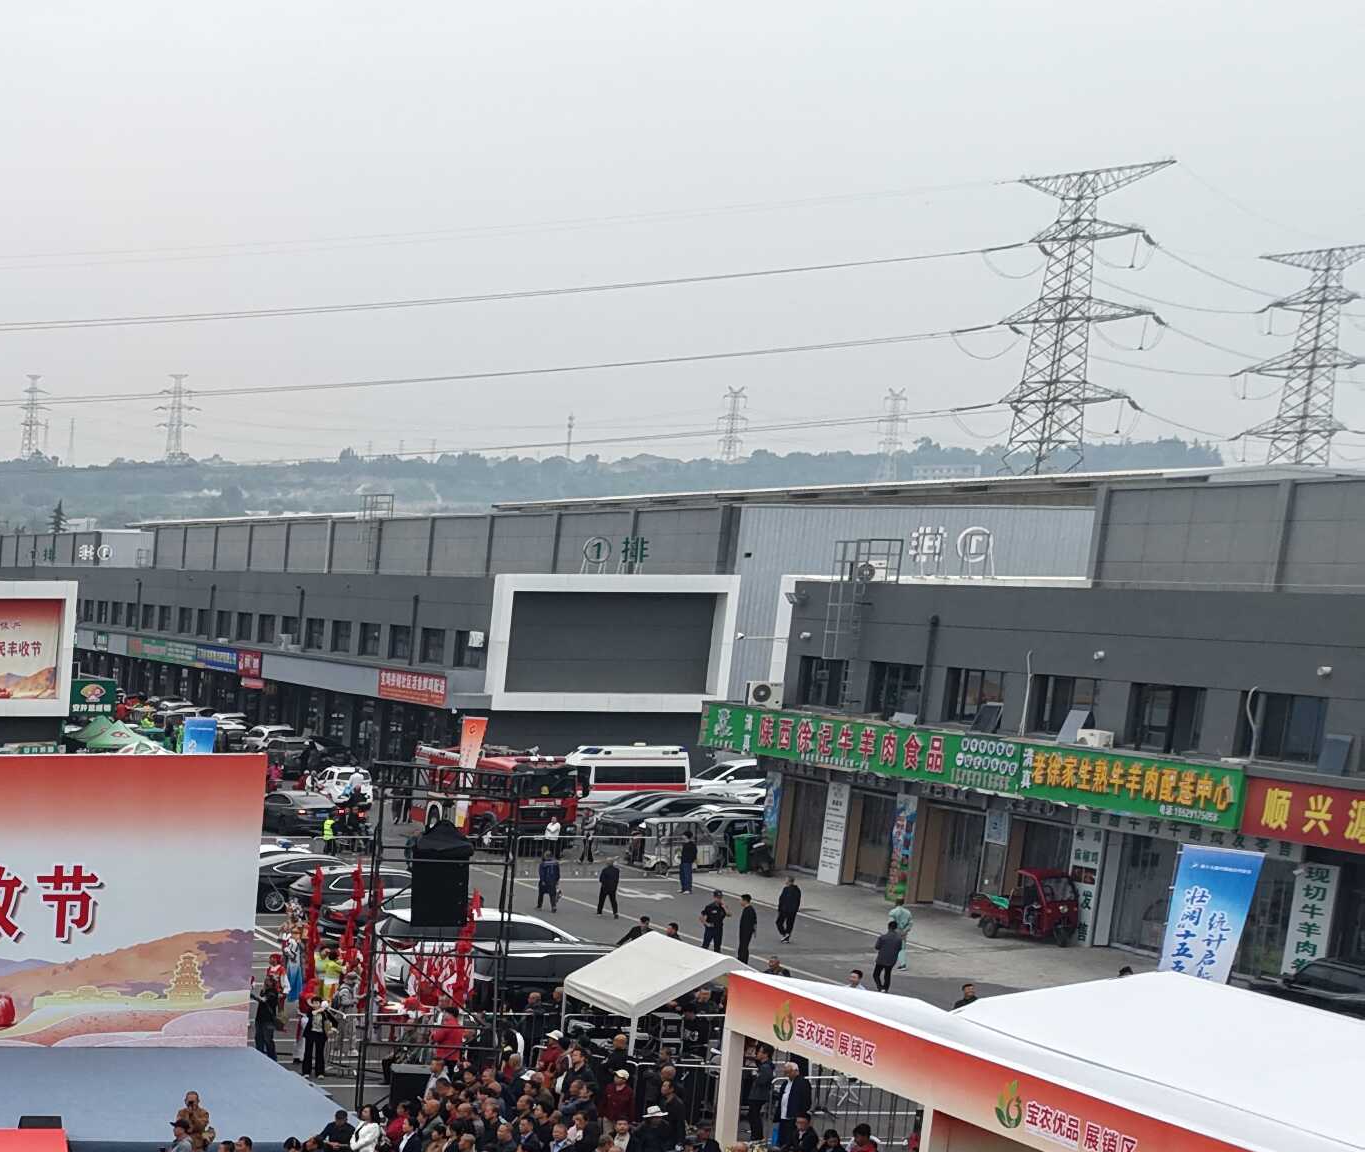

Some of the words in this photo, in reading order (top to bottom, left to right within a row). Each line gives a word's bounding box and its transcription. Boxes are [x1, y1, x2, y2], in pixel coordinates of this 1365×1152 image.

[758, 715, 945, 773] 陕西徐记牛羊肉食品
[795, 1017, 836, 1049] 宝农优品
[837, 1031, 876, 1066] 展销区
[1025, 1101, 1079, 1143] 宝农优品
